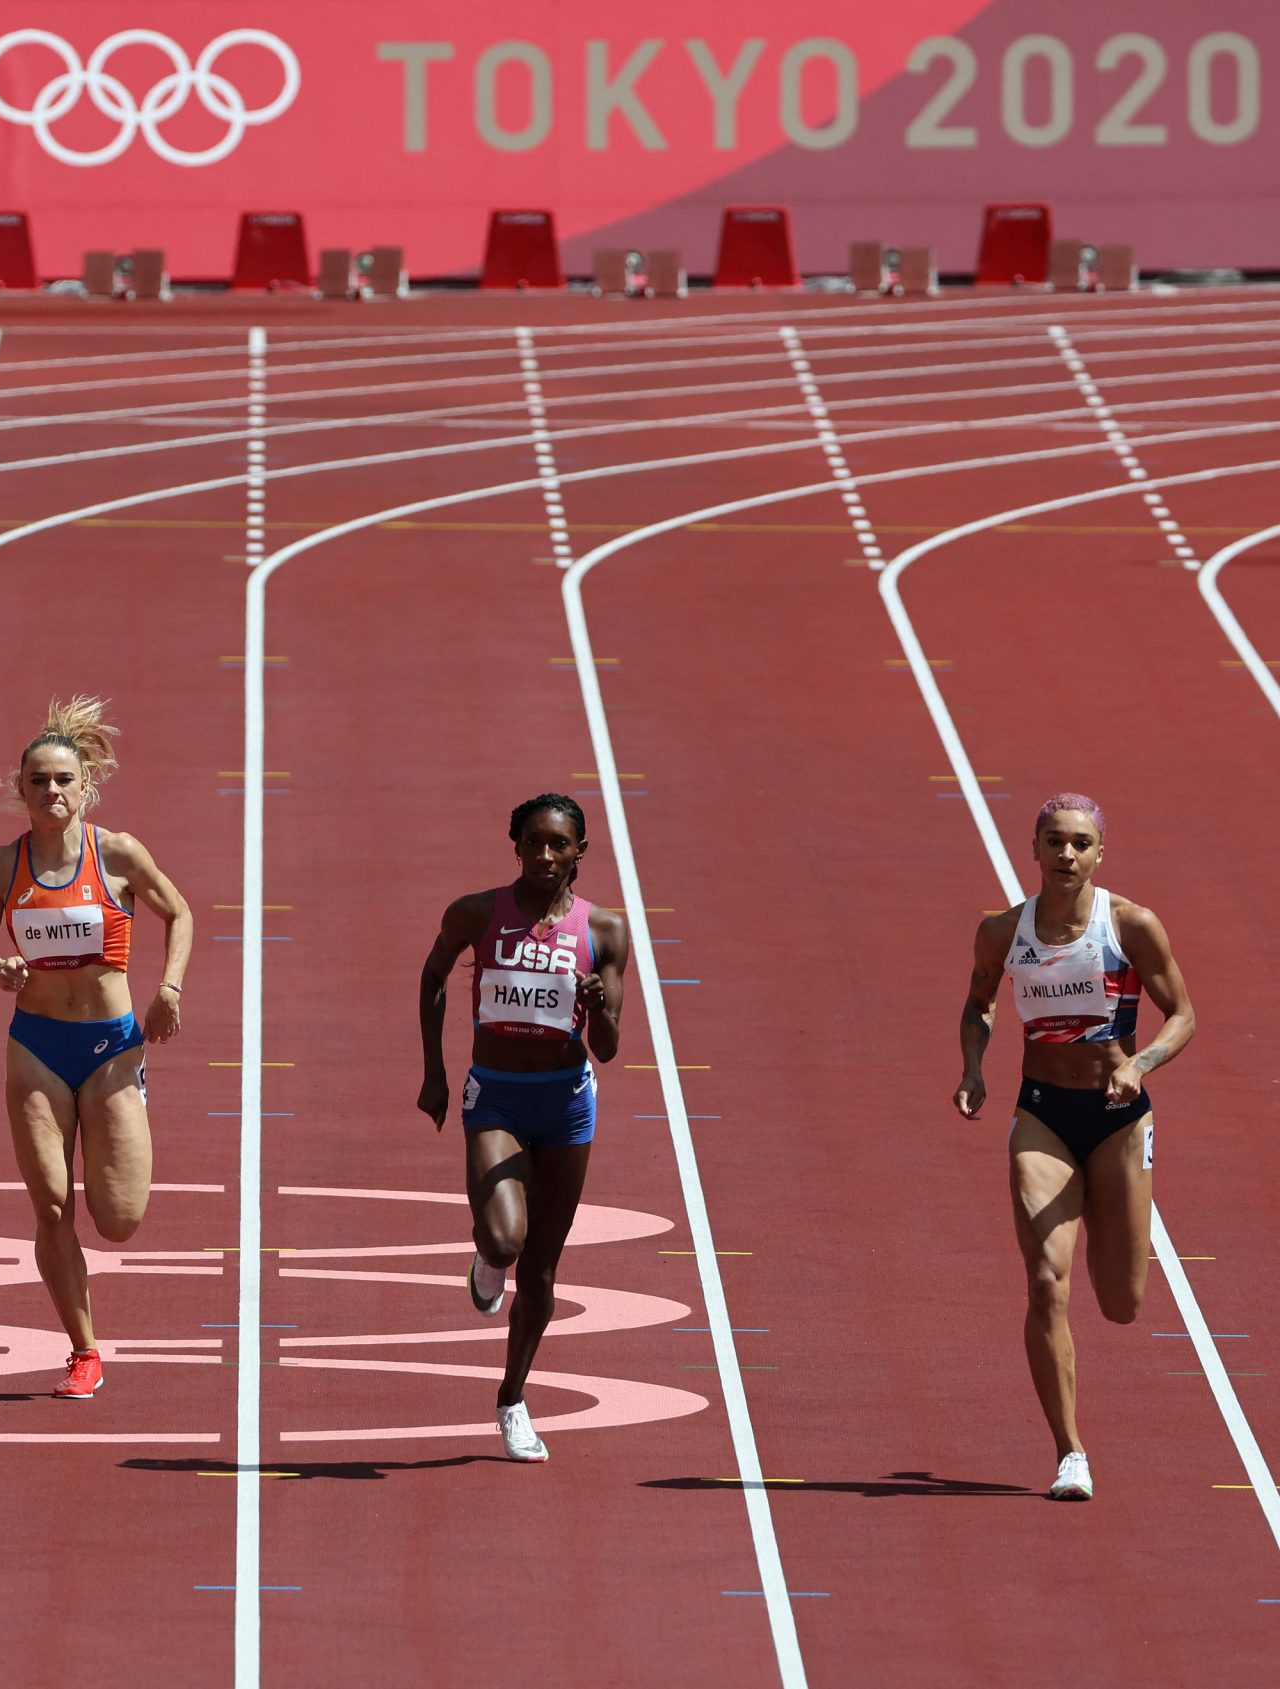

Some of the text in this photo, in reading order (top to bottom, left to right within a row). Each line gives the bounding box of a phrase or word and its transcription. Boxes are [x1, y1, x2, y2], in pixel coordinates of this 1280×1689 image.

[376, 31, 1263, 152] TOKYO 2020
[25, 922, 92, 940] de WITTE
[494, 939, 577, 976] USA
[1018, 957, 1040, 965] adidas
[494, 984, 560, 1009] HAYES
[1022, 980, 1094, 998] J.WILLIAMS
